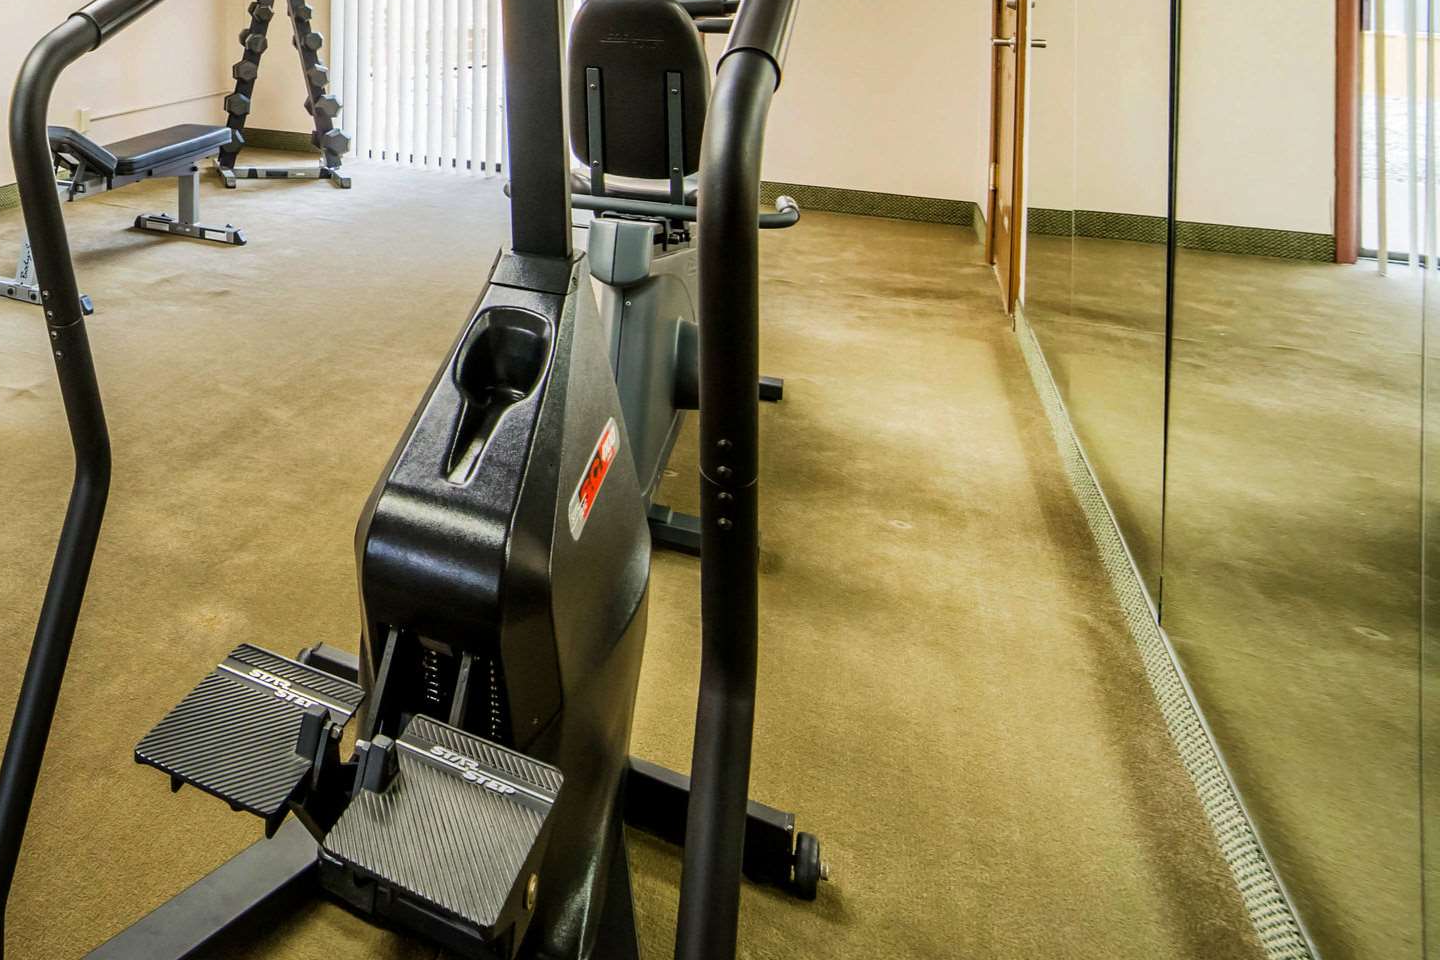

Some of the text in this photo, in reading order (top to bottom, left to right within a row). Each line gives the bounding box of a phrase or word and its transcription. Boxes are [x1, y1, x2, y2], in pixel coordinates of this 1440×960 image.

[248, 668, 291, 691] STAR
[430, 745, 480, 771] STAR
[463, 770, 517, 795] STEP
